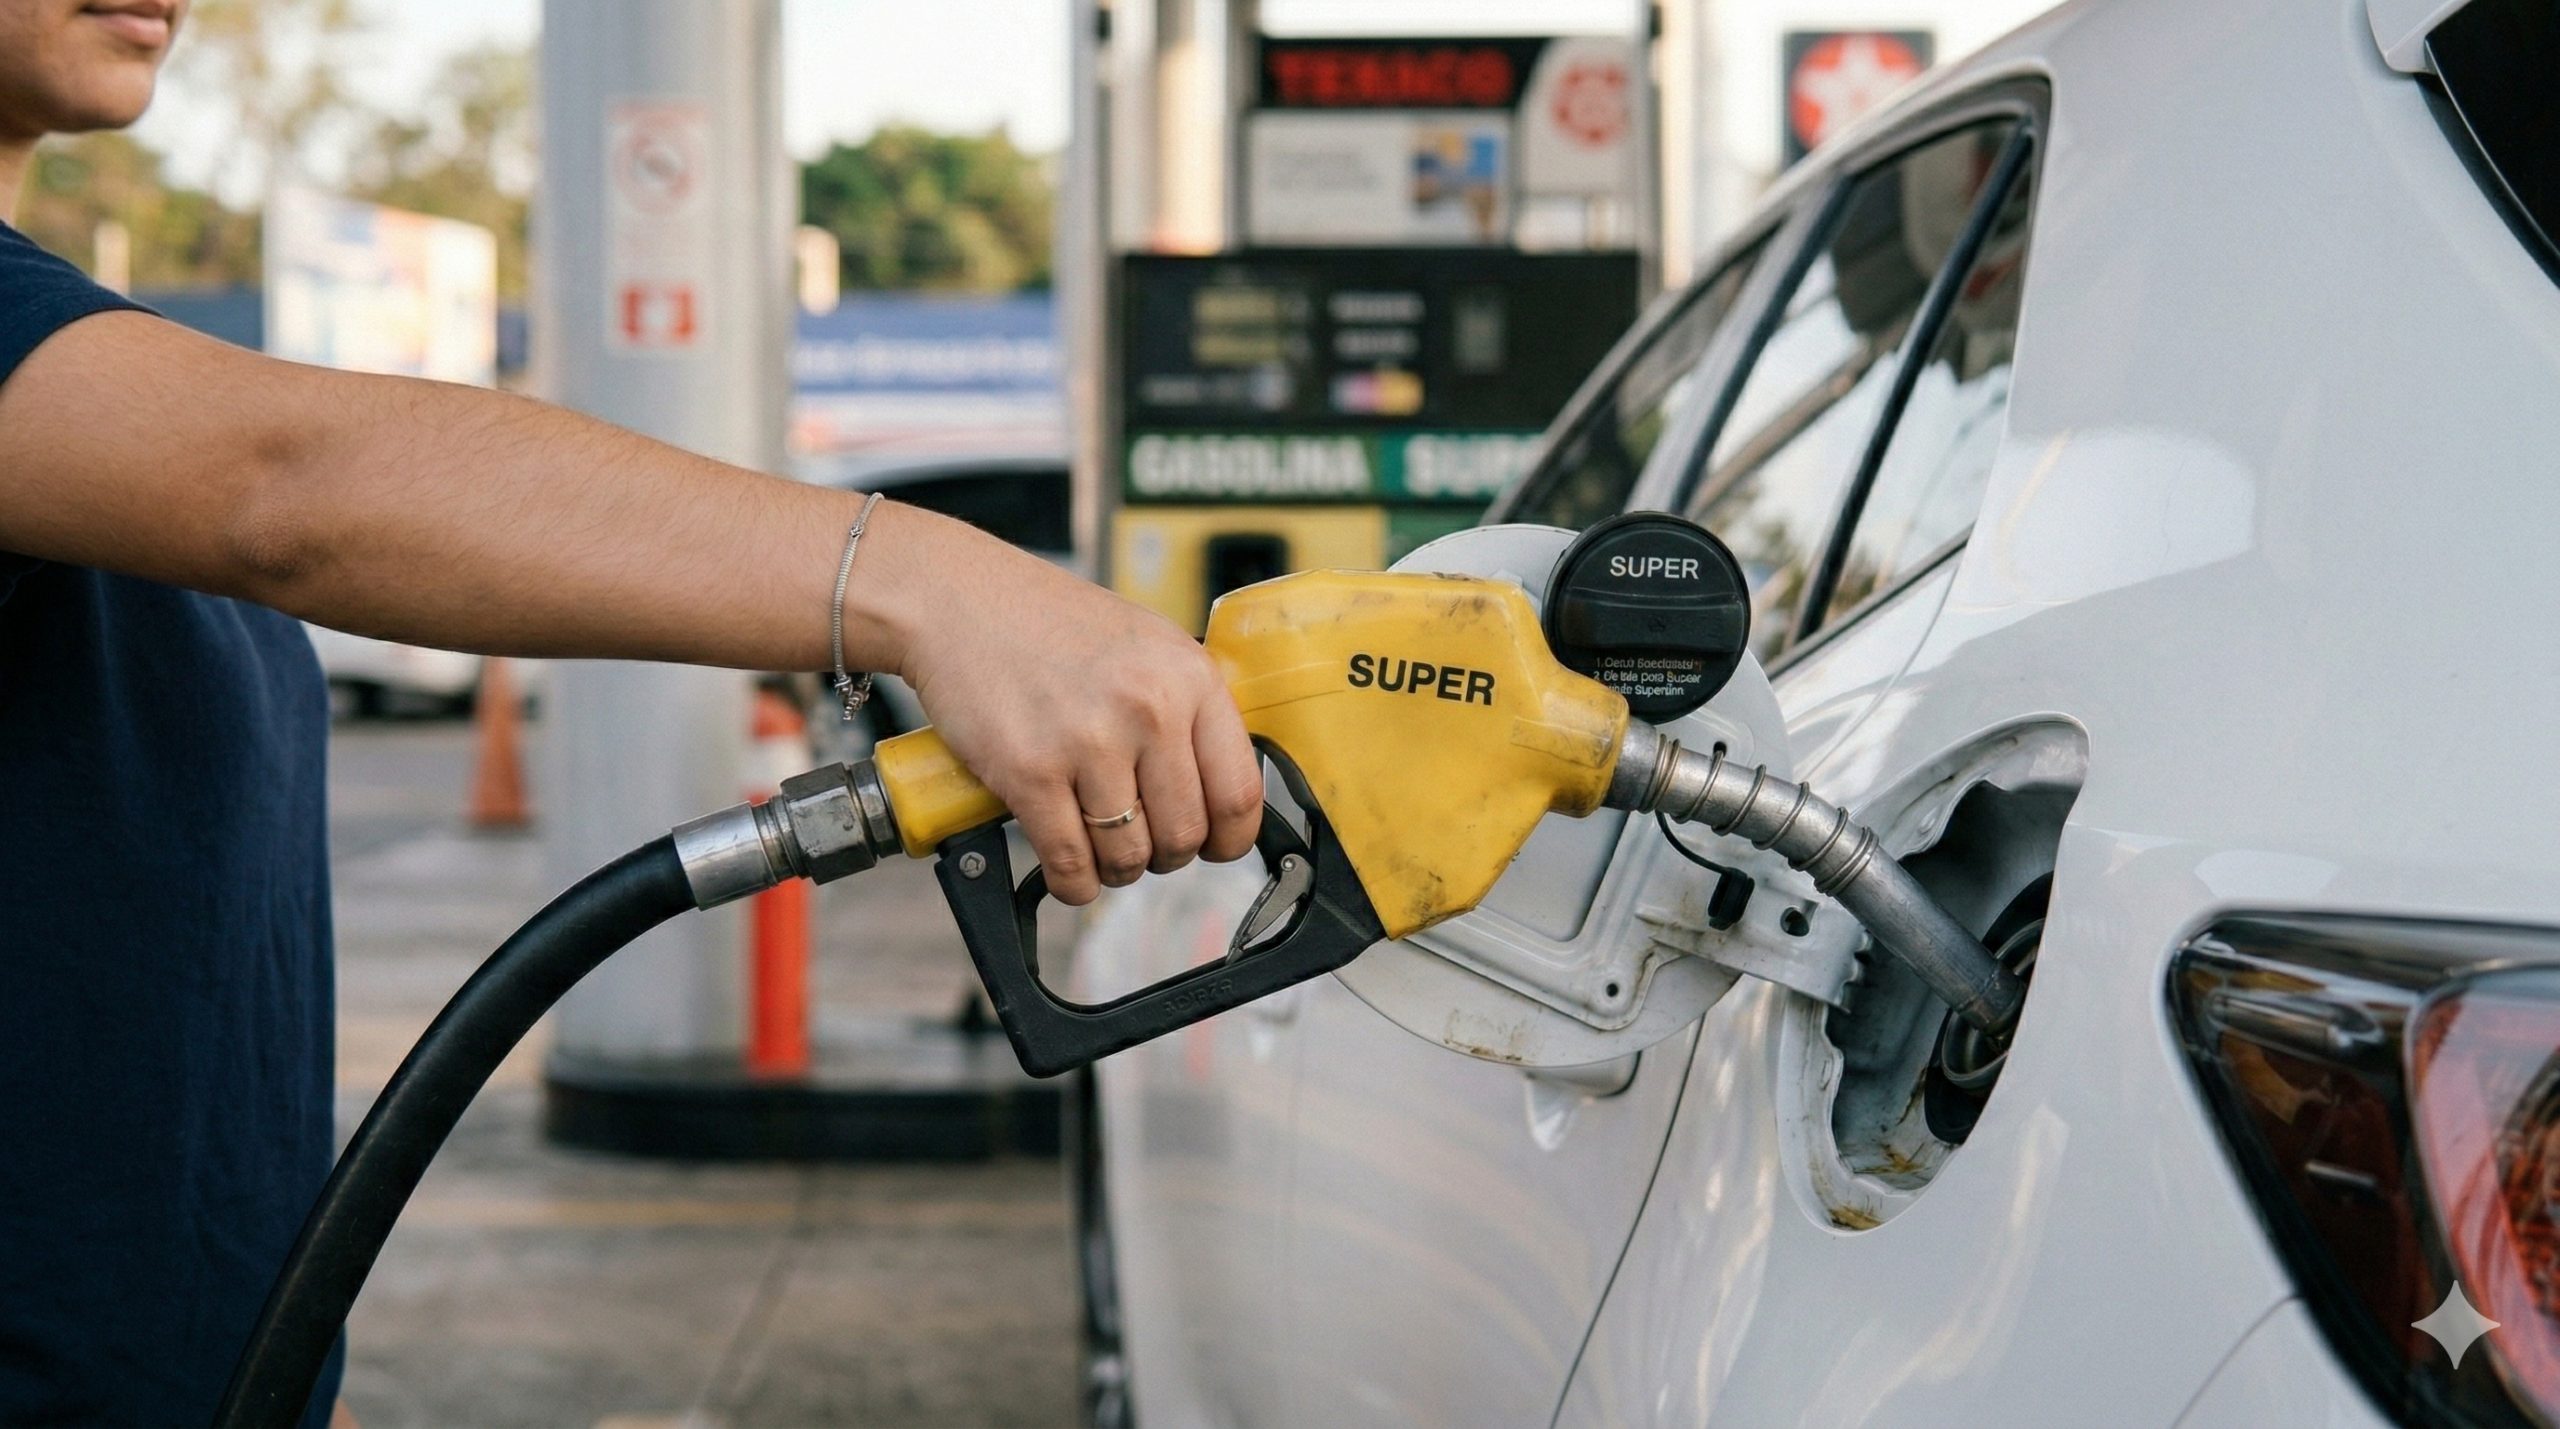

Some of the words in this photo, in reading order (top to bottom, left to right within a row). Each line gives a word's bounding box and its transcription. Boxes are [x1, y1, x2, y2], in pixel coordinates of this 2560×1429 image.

[1129, 434, 1372, 495] GASOLINA
[1610, 555, 1699, 580] SUPER
[1347, 653, 1495, 706] SUPER
